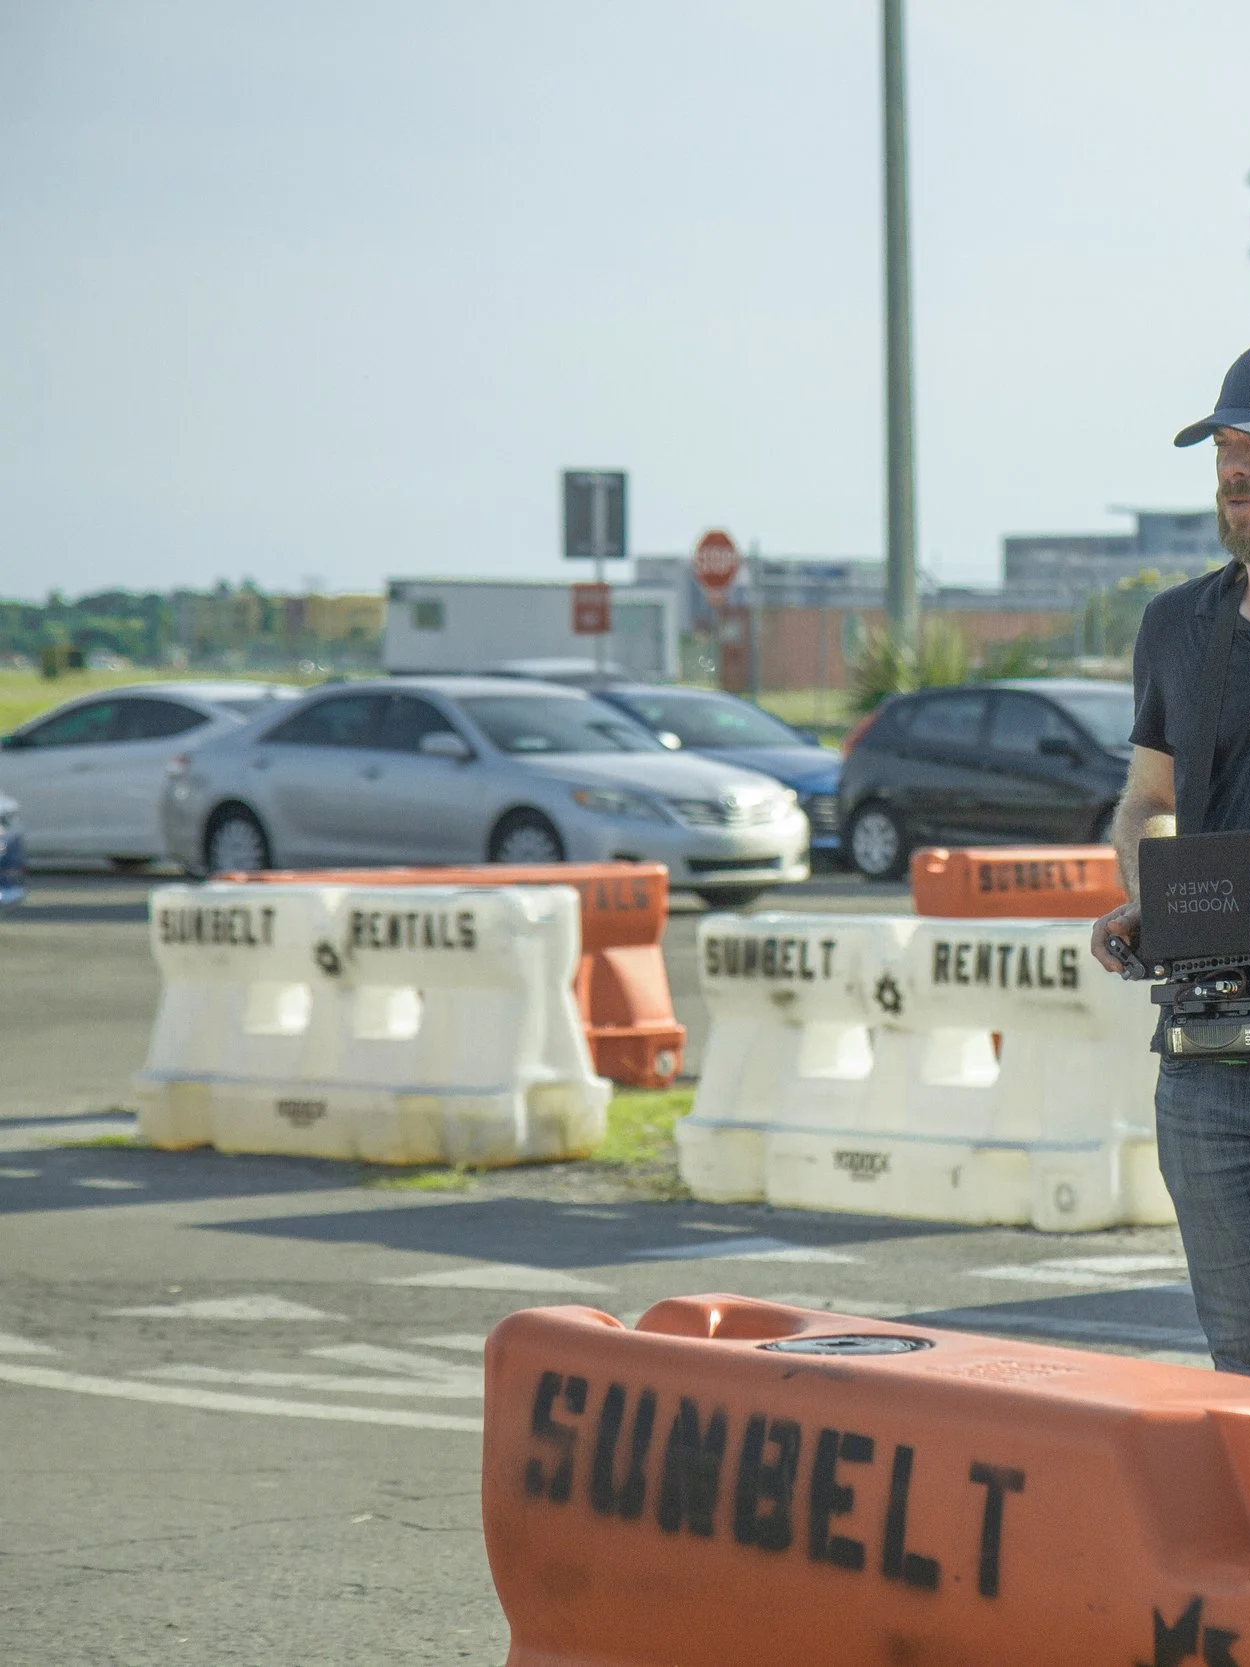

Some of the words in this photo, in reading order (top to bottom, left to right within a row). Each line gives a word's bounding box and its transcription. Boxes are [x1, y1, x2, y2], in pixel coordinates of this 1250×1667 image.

[159, 904, 274, 945] SUNBELT
[351, 909, 477, 950] RENTALS
[1167, 897, 1240, 914] WOODEN
[705, 936, 837, 980] SUNBELT
[933, 939, 1080, 990] RENTALS
[525, 1370, 1026, 1597] SUNBELT
